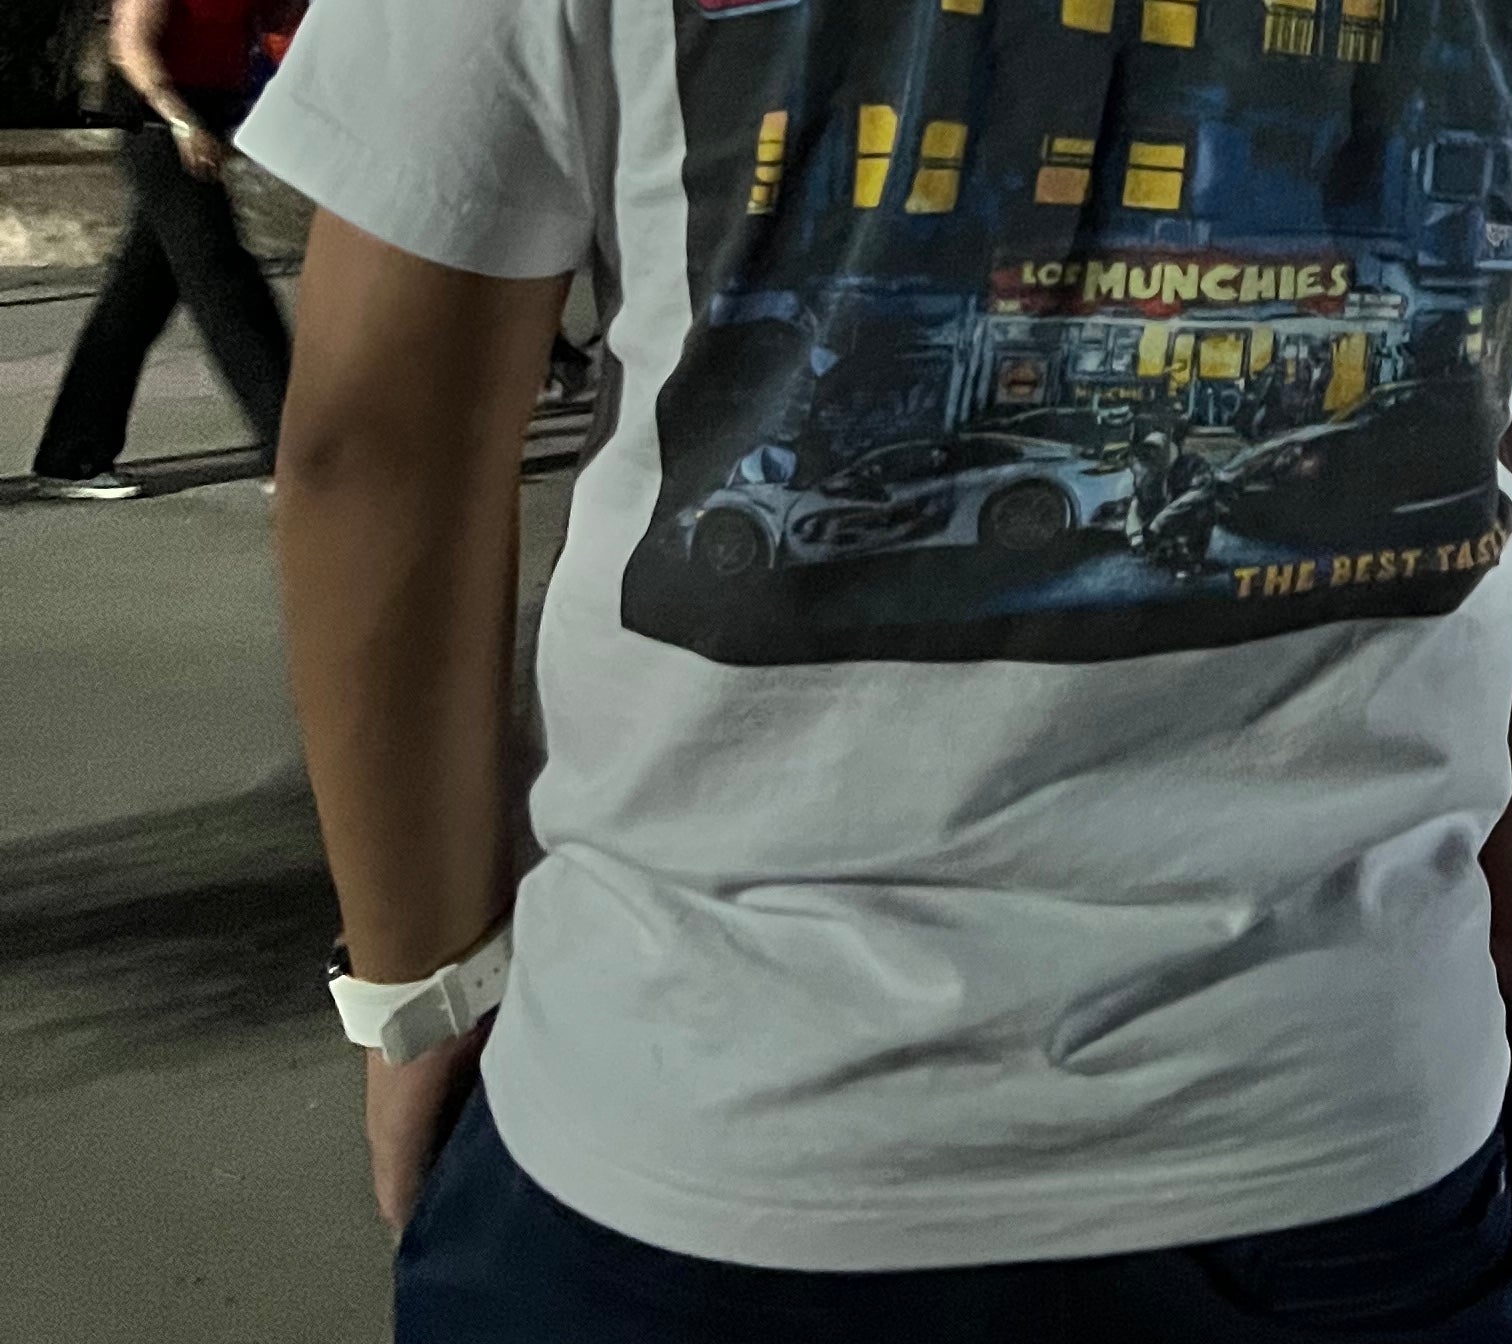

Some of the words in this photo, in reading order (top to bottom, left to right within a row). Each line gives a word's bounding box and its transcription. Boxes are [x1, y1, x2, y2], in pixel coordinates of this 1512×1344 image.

[1081, 260, 1349, 305] MUNCHIES
[1233, 559, 1318, 599] THE
[1329, 547, 1423, 588] BEST
